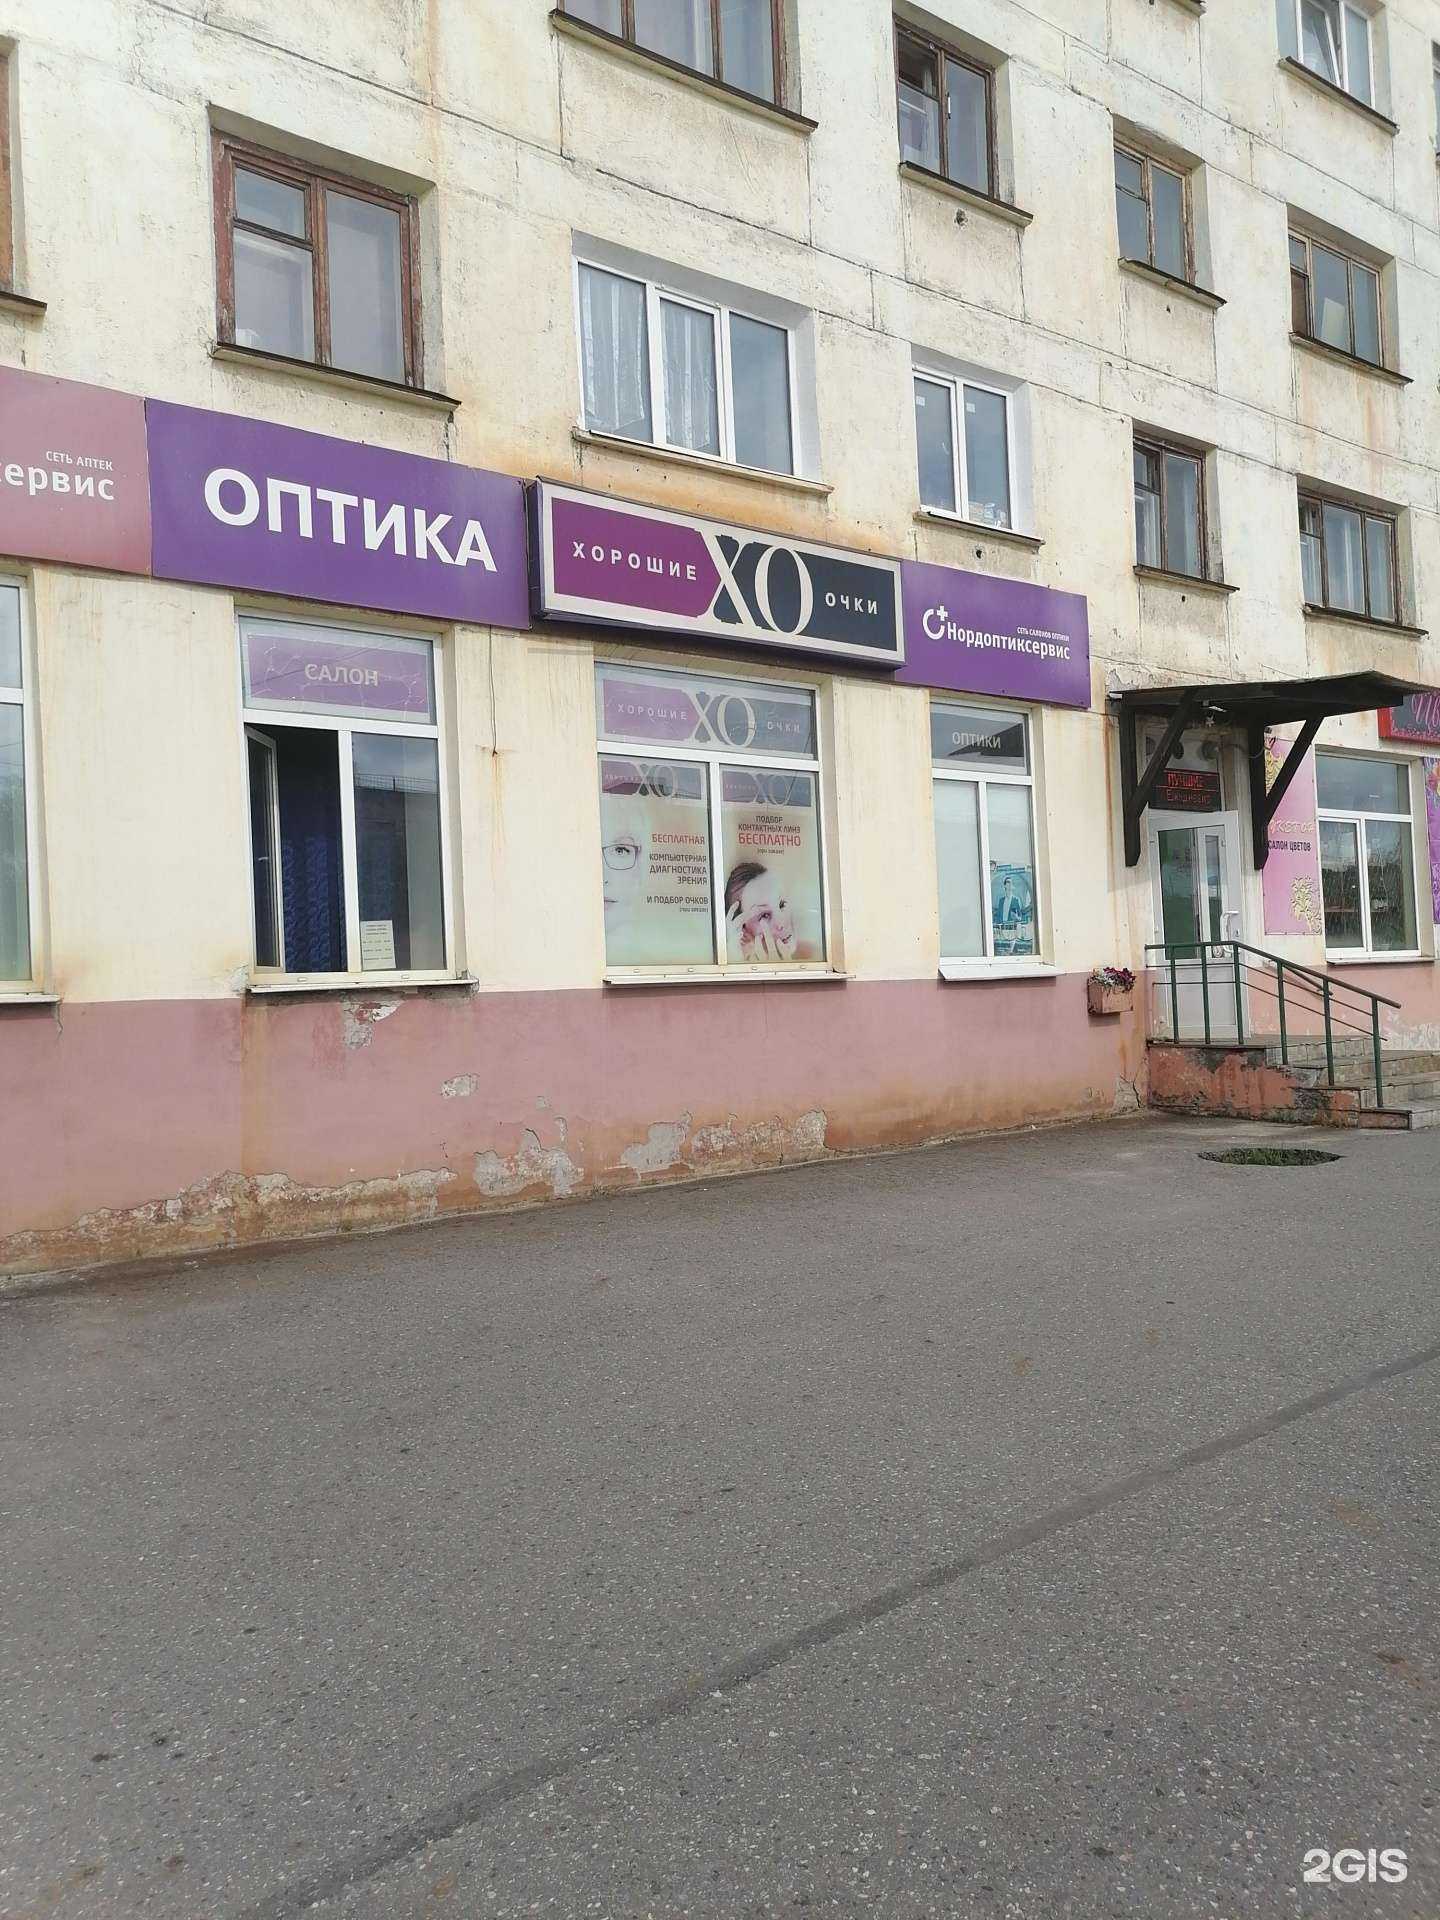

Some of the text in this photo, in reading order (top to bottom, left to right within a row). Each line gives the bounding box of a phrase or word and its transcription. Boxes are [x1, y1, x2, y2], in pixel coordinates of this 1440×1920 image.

[46, 450, 114, 471] СЕТЬ АПТЕК
[0, 462, 115, 500] ервис
[204, 468, 498, 572] ОПТИКА
[573, 541, 697, 580] ХОРОШИЕ
[825, 592, 878, 615] ОЧКИ
[947, 621, 1071, 660] Нордоптиксервис
[1017, 626, 1070, 642] СЕТЬ САЛОНОВ ОПТИКИ
[304, 663, 378, 687] САЛОН
[617, 703, 688, 720] ХОРОШИЕ
[767, 721, 800, 733] ОЧКИ
[952, 731, 1001, 749] ОПТИКИ
[755, 815, 784, 824] ПОДБОР
[738, 823, 801, 833] КОНТАКТНЫХ ЛИНЗ
[652, 833, 705, 845] БЕСПЛАТНАЯ
[738, 833, 801, 847] БЕСПЛАТНО
[1268, 839, 1312, 852] САЛОН ЦВЕТОВ
[649, 853, 707, 863] КОМПЬЮТЕРНАЯ
[649, 865, 707, 875] ДИАГНОСТИКА
[677, 876, 708, 885] ЗРЕНИЯ
[646, 895, 709, 905] И ПОДБОР ОЧКОВ
